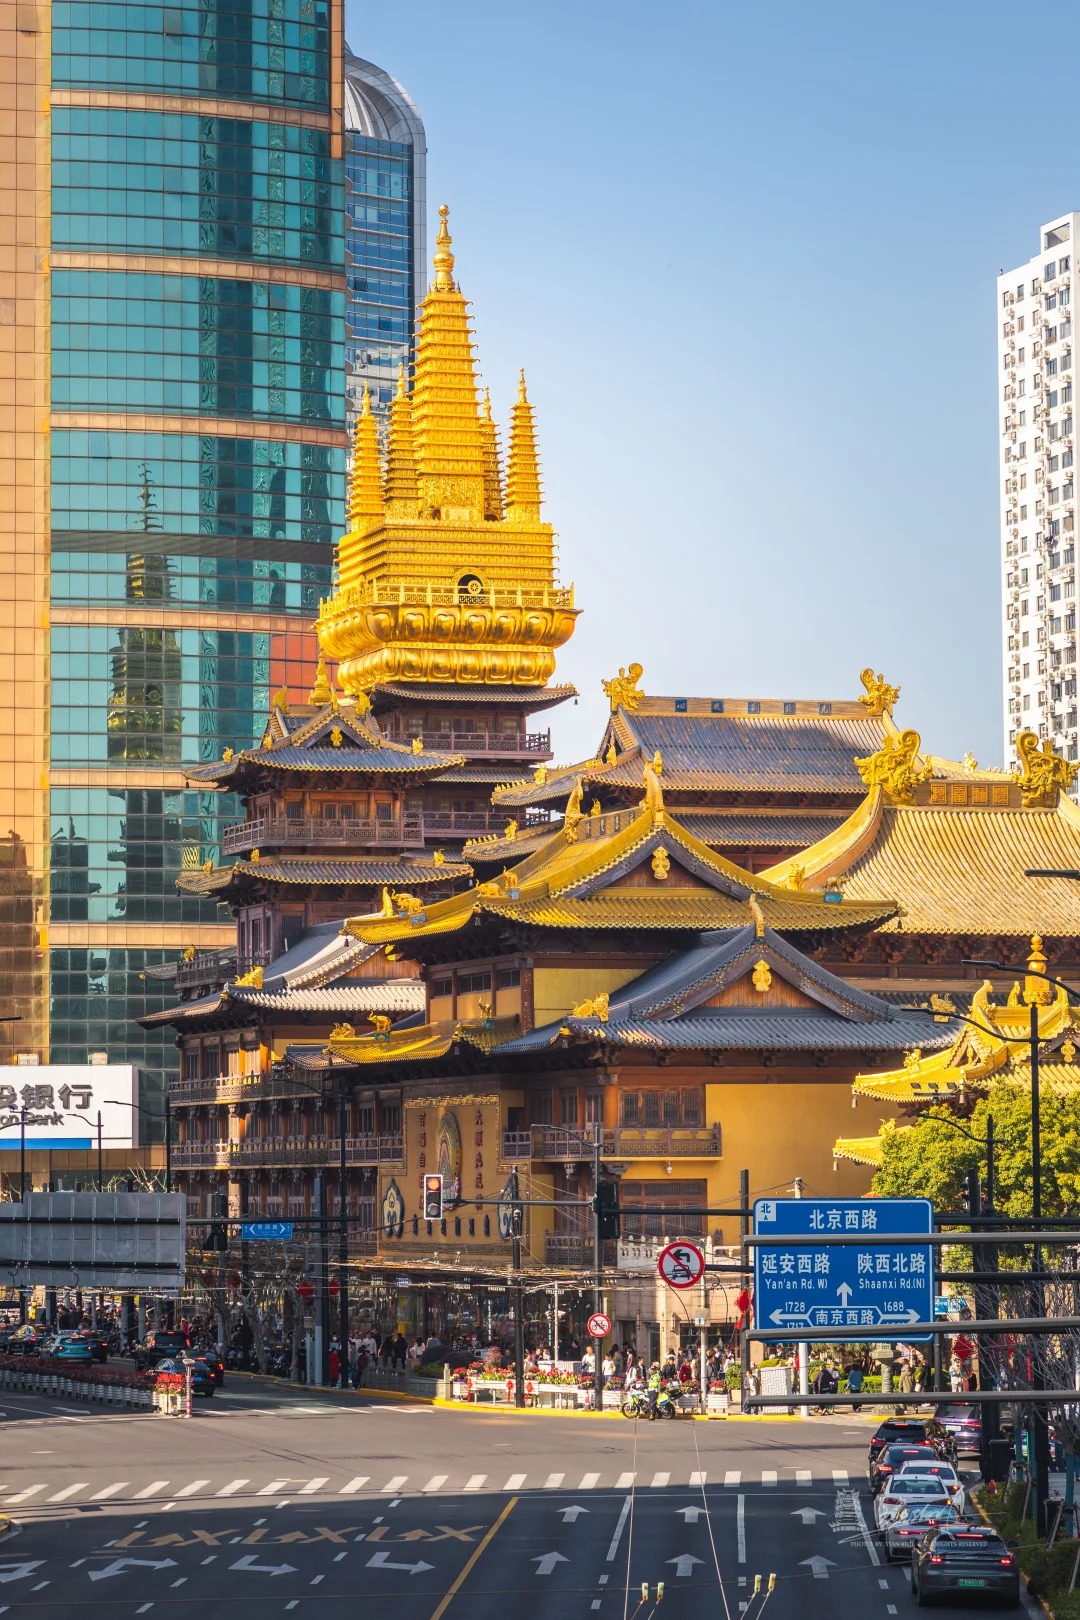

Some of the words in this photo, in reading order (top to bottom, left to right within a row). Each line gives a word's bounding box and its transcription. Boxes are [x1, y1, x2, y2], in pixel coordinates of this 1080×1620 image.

[760, 1203, 772, 1214] 北
[809, 1209, 878, 1230] 北京西路
[762, 1253, 831, 1275] 延安西路
[857, 1253, 926, 1274] 陕西北路
[765, 1278, 798, 1290] Yan'an
[859, 1278, 897, 1289] Shaanxi
[785, 1302, 806, 1312] 1728
[883, 1301, 905, 1312] 1688
[815, 1309, 875, 1325] 南京西路
